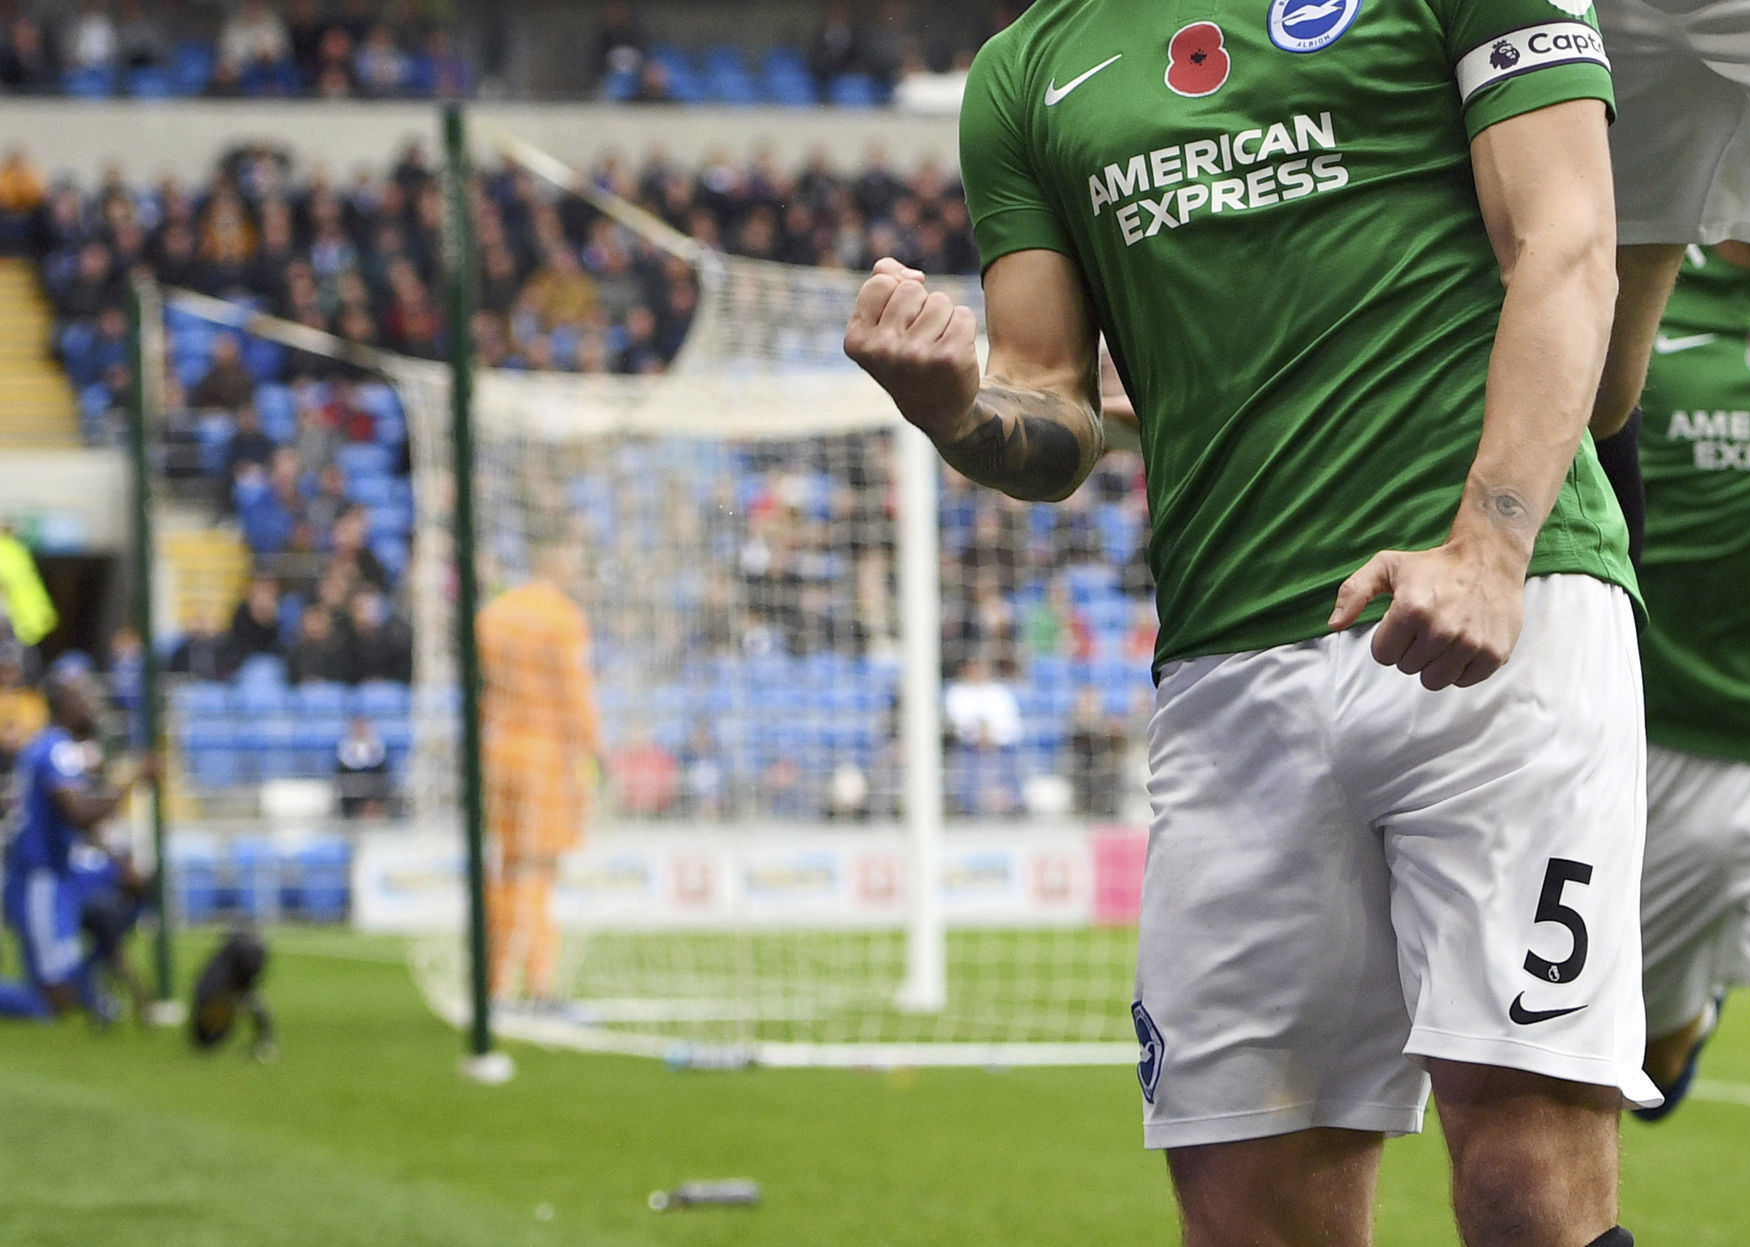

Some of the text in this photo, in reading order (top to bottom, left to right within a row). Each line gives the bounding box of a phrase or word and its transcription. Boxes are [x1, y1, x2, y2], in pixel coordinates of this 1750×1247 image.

[1296, 34, 1330, 48] ALBION
[1528, 33, 1602, 54] Capt
[1089, 112, 1335, 216] AMERICAN
[1116, 153, 1349, 246] EXPRESS
[1523, 857, 1593, 984] 5
